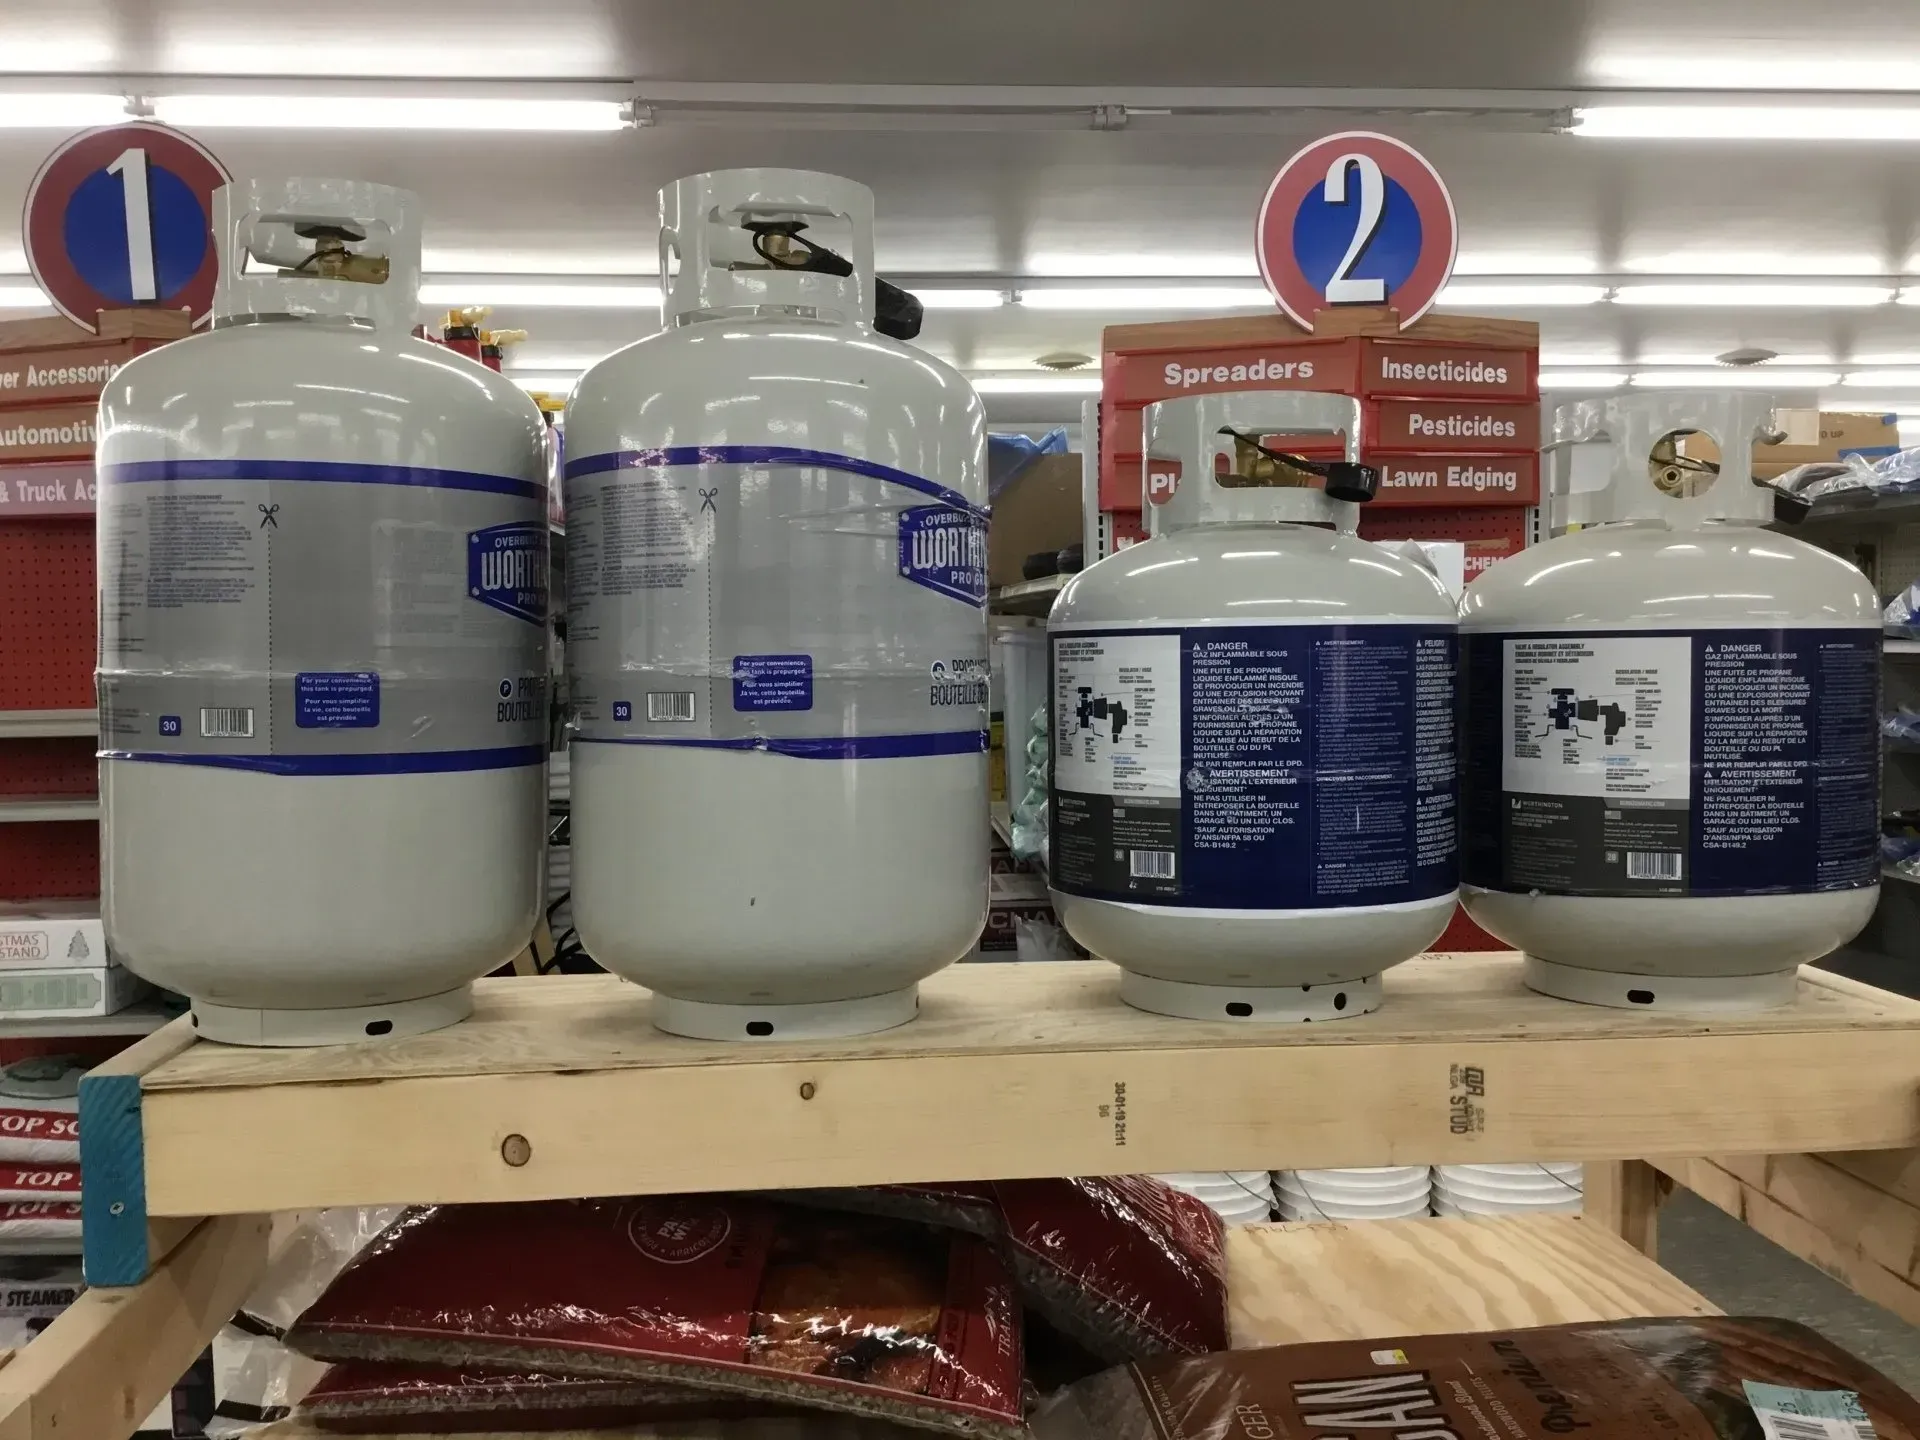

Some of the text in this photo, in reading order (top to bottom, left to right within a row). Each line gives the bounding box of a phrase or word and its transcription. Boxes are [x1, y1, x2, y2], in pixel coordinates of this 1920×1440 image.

[106, 148, 156, 300] 1
[1324, 154, 1384, 302] 2
[26, 359, 124, 387] Accessorie
[1164, 359, 1313, 387] Spreaders
[1382, 357, 1507, 383] Insecticides
[1409, 414, 1515, 436] Pesticides
[1151, 473, 1179, 494] Pl
[1382, 466, 1516, 491] Lawn Edging
[0, 482, 9, 502] &
[17, 479, 67, 502] Truck
[1464, 556, 1504, 571] CHE
[951, 570, 971, 585] PRO
[1721, 644, 1762, 652] DANGER
[616, 706, 628, 716] 30
[163, 720, 177, 732] 30
[1210, 769, 1289, 777] AVERTISSEMENT
[1721, 770, 1797, 778] AVERTISSEMENT
[1450, 1096, 1468, 1134] STUD
[15, 1171, 73, 1186] TOP
[7, 1288, 76, 1307] STEAMER
